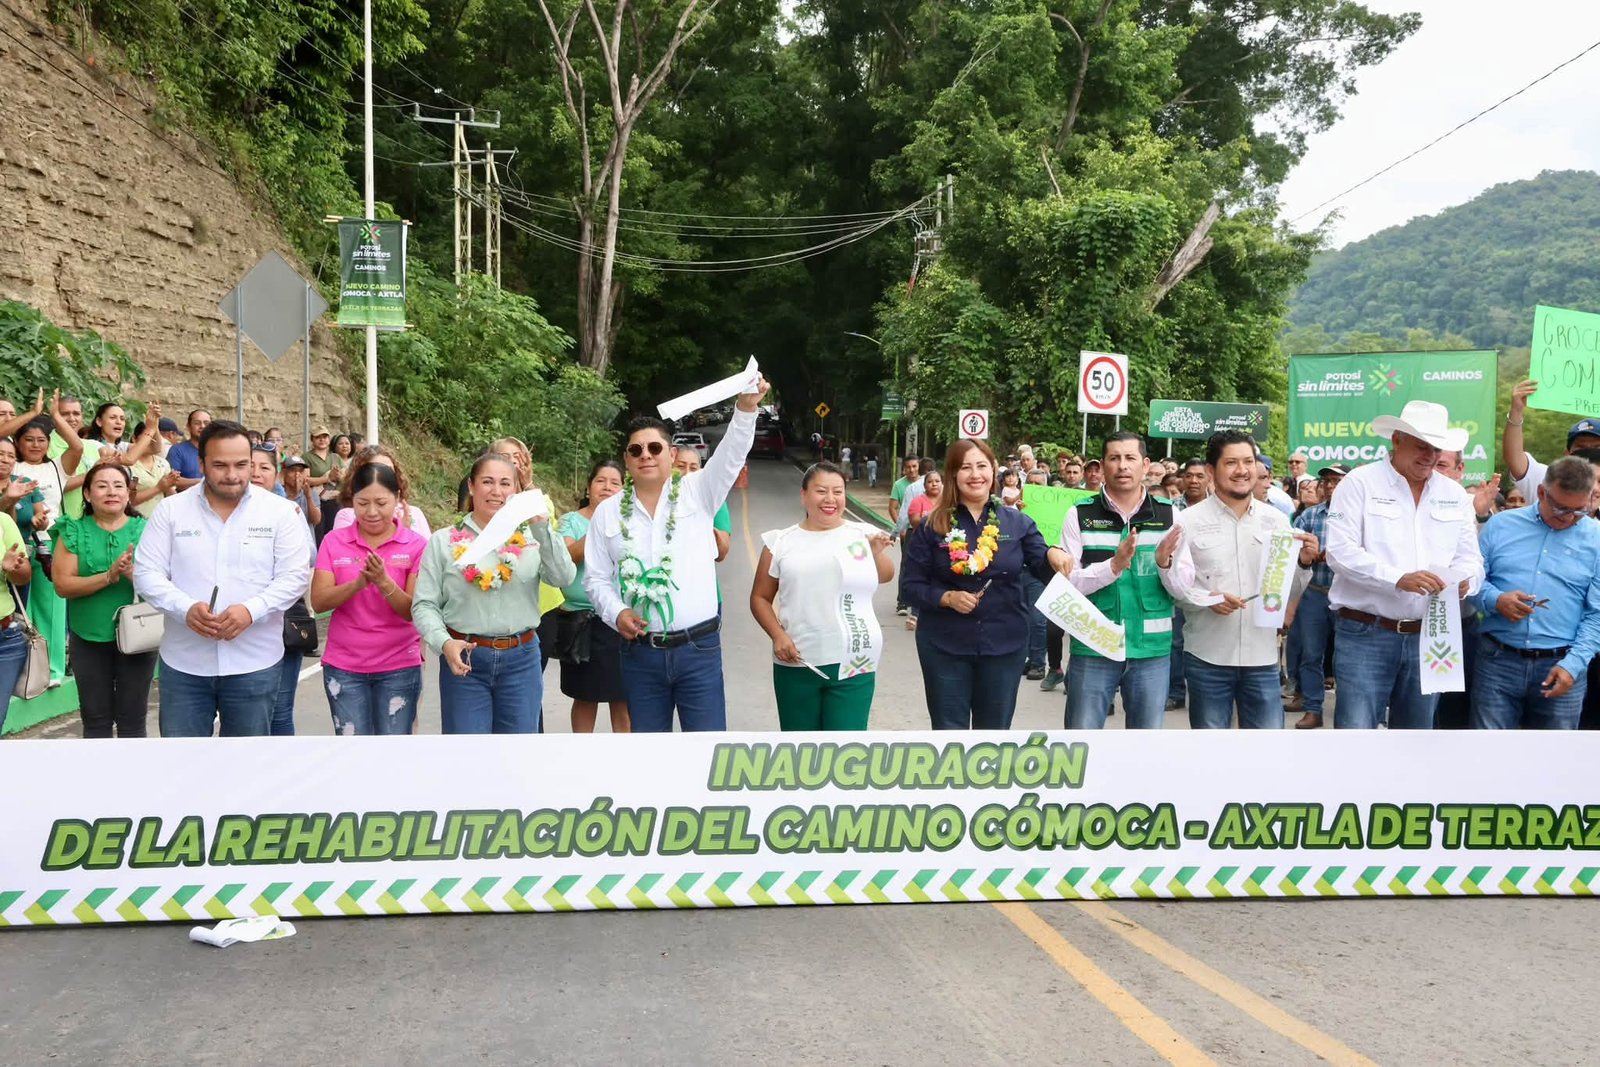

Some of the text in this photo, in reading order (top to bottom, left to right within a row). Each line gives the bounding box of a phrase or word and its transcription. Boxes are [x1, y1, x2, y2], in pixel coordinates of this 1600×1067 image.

[1092, 370, 1115, 391] 50
[1325, 370, 1362, 380] POTOSÍ
[1423, 370, 1483, 381] CAMINOS
[1541, 347, 1599, 394] COM
[1297, 379, 1365, 392] sin límites
[1174, 406, 1193, 416] ESTA
[843, 593, 853, 612] sin
[846, 613, 861, 652] límites
[707, 732, 1089, 792] INAUGURACIÓN
[41, 818, 132, 871] DE
[128, 816, 205, 868] LA
[208, 796, 656, 866] REHABILITACIÓN
[657, 806, 759, 857] DEL
[763, 804, 968, 852] CAMINO
[969, 792, 1180, 851] CÓMOCA
[1183, 820, 1209, 841] -
[1210, 802, 1363, 849] AXTLA
[1365, 803, 1432, 850] DE
